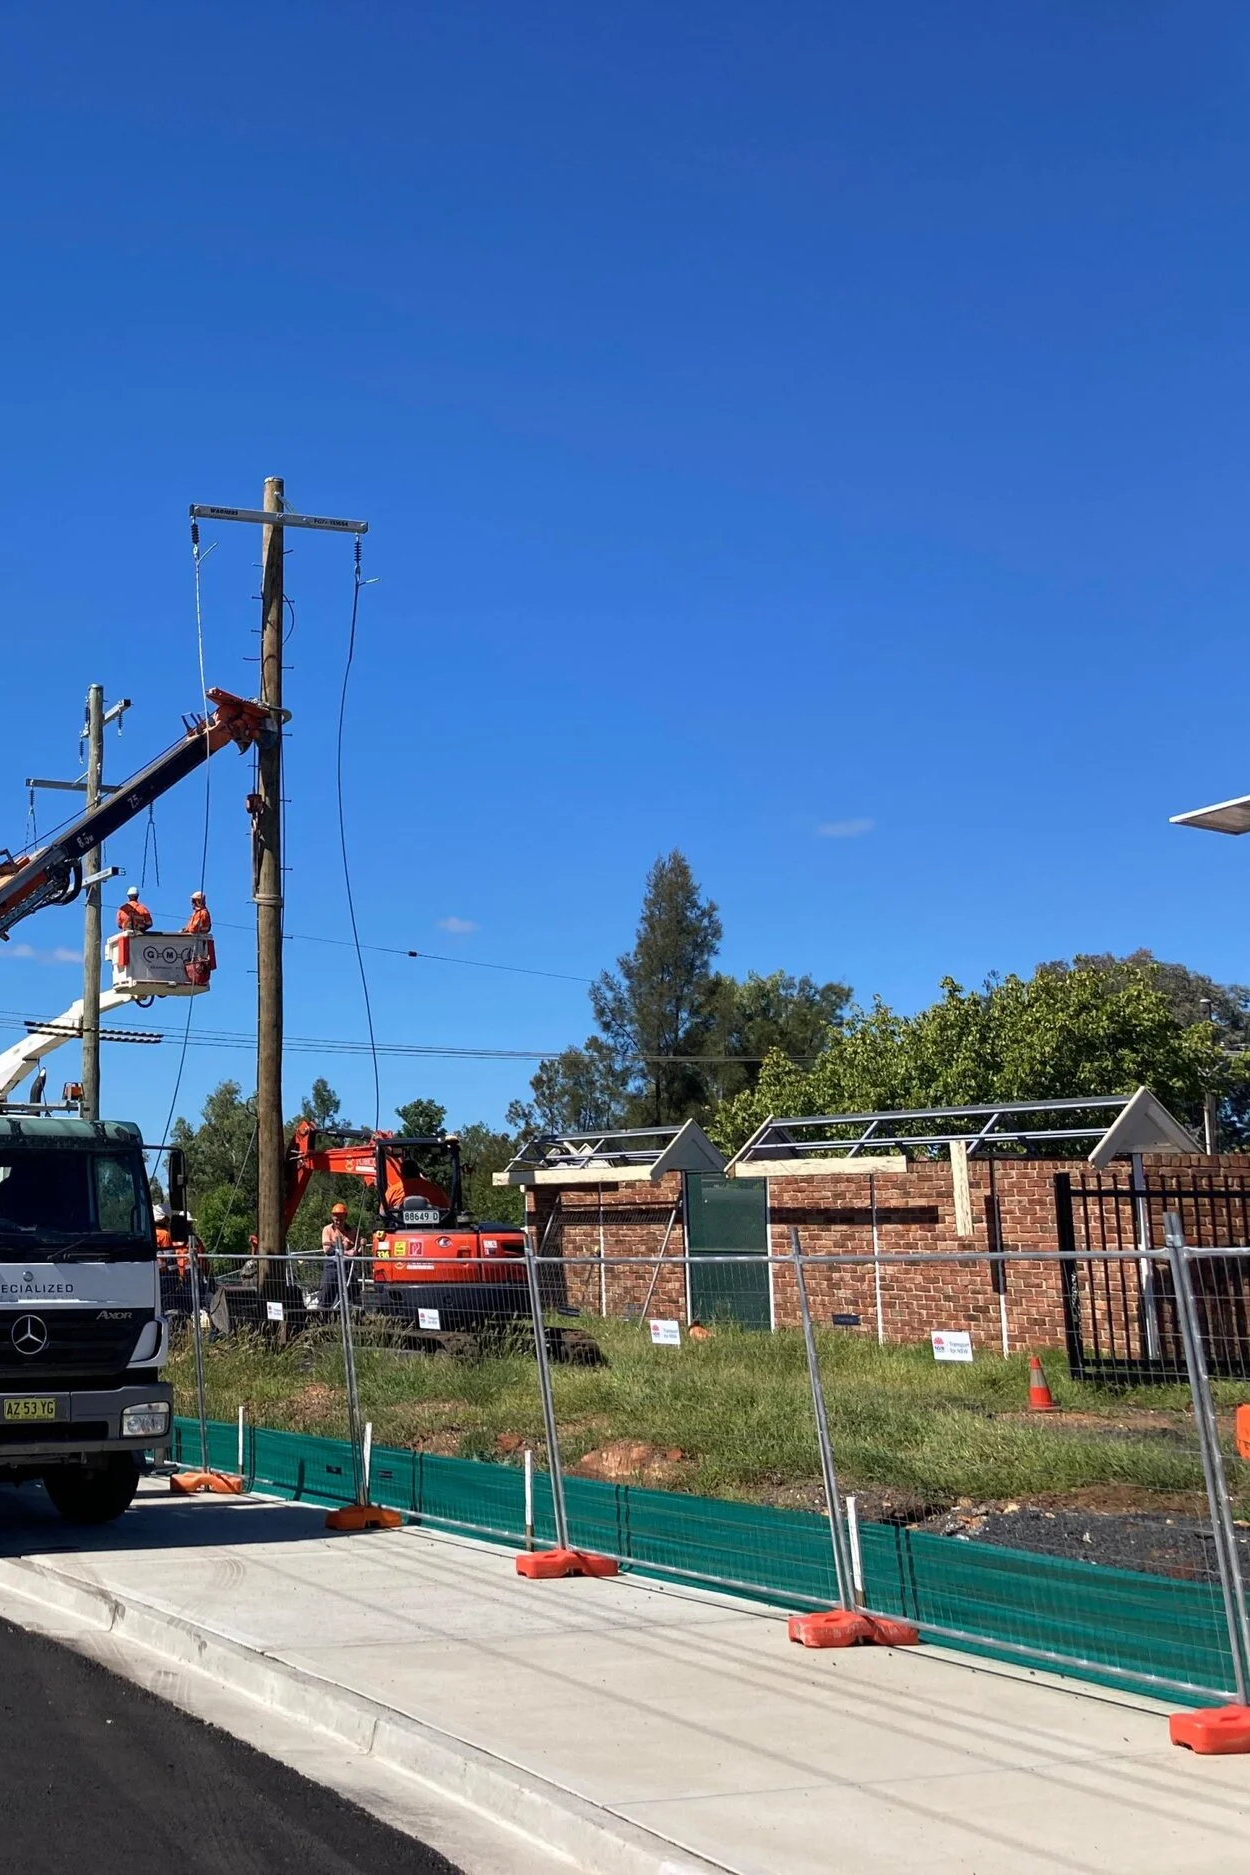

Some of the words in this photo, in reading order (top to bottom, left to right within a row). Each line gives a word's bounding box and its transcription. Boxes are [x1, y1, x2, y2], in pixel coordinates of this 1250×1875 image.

[405, 1212, 429, 1221] 88649
[6, 1402, 20, 1415] AZ
[23, 1401, 37, 1415] 53
[41, 1401, 54, 1414] YG
